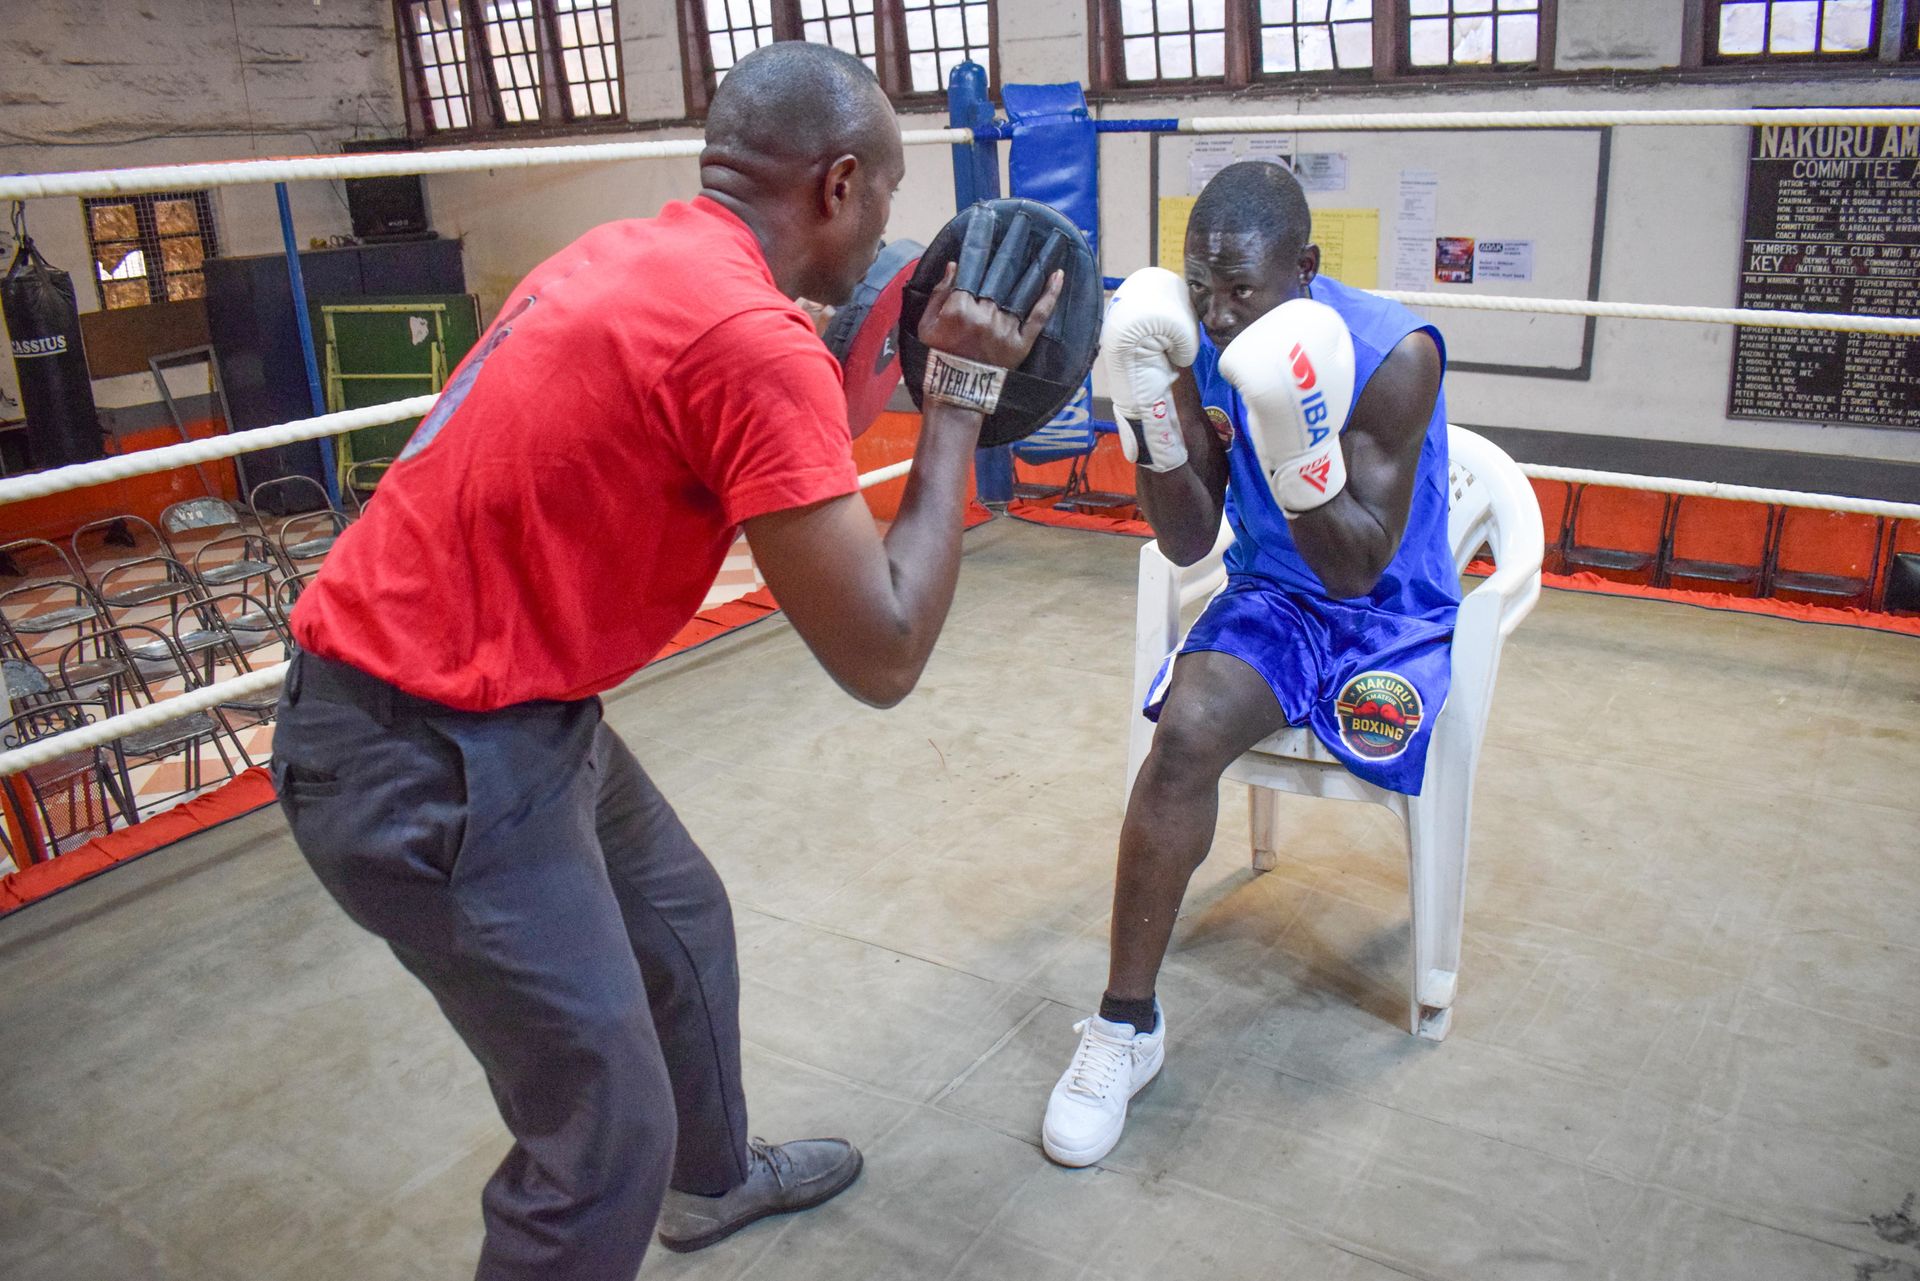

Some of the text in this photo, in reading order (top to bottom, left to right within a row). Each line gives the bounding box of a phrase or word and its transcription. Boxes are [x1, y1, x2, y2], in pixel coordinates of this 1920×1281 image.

[1760, 126, 1920, 158] NAKURU AM
[1792, 160, 1900, 178] COMMITTEE
[1800, 232, 1834, 240] MANAGER
[1752, 244, 1920, 258] MEMBERS OF THE CLUB WHO HA
[1750, 255, 1784, 272] KEY
[12, 335, 67, 354] ASSIUS
[928, 355, 998, 410] EVERLAST
[1299, 390, 1331, 448] IBA
[1355, 678, 1412, 702] NAKURU
[1366, 692, 1398, 706] AMATEUR
[1352, 718, 1404, 742] BOXING
